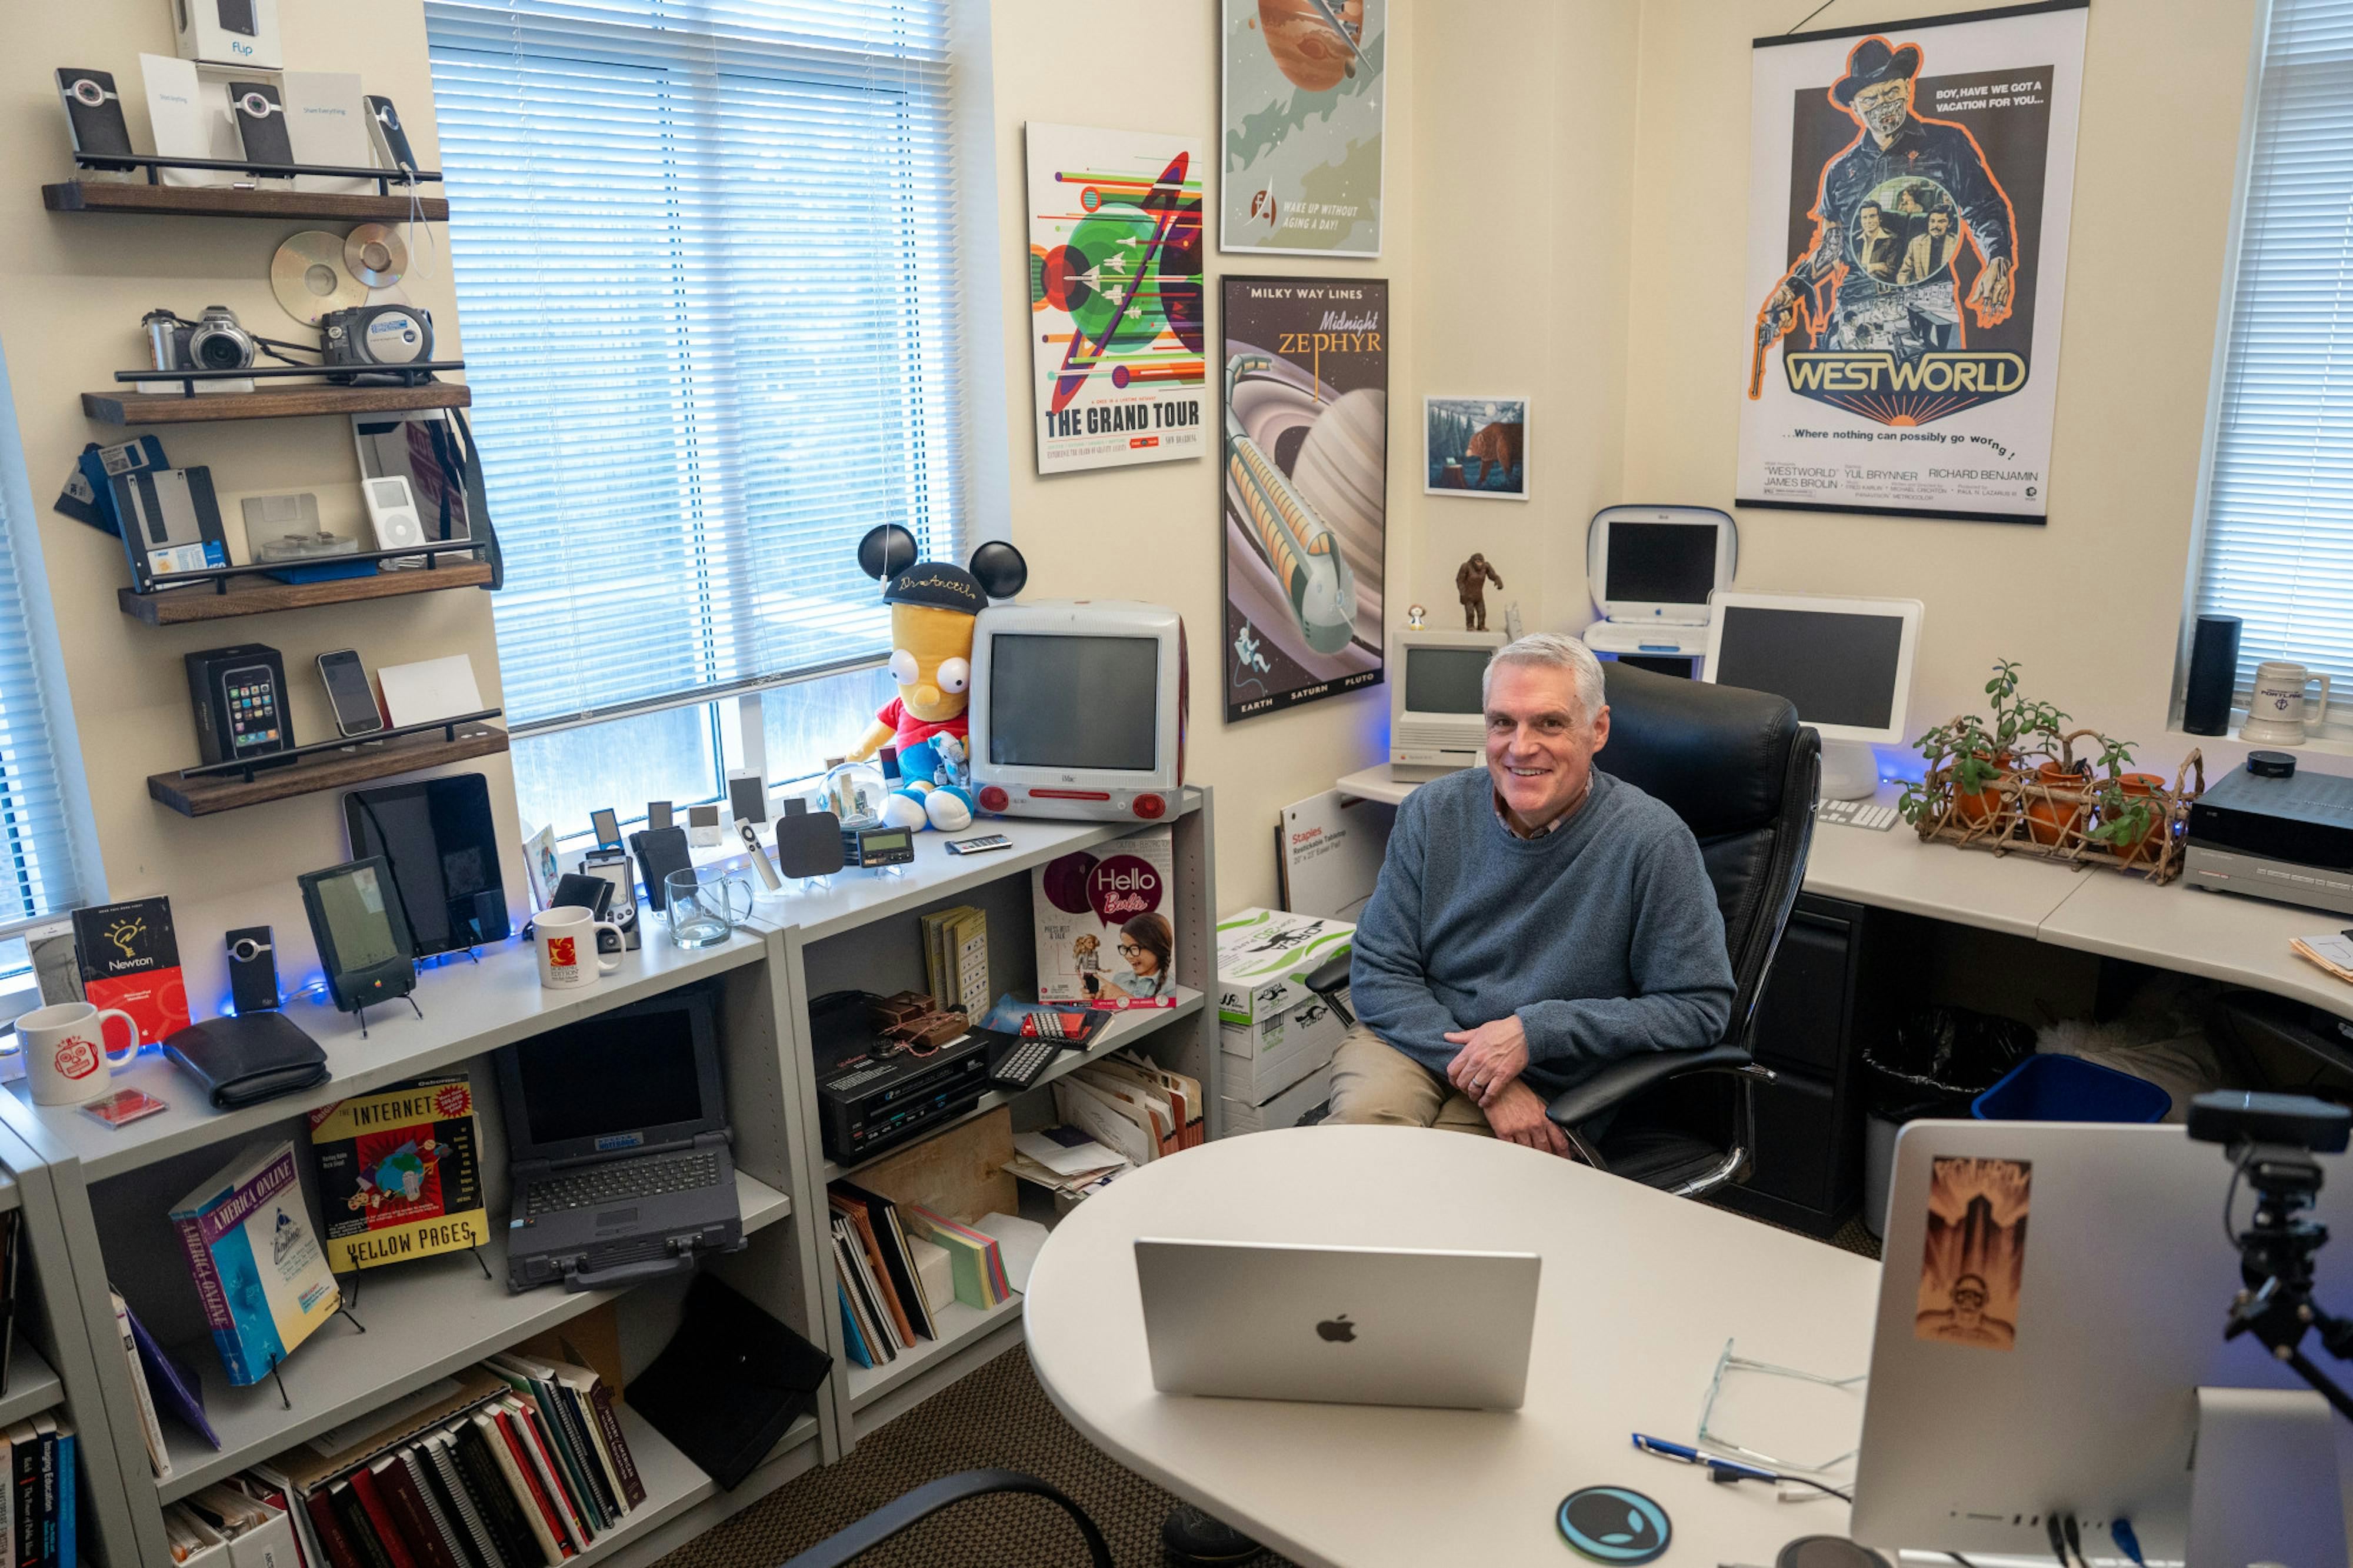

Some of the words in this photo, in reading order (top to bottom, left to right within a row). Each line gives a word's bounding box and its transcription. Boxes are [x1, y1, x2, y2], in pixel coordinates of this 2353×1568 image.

[1936, 89, 1959, 99] BOY,
[1960, 86, 1988, 96] HAVE
[1991, 84, 2009, 94] WE
[2011, 82, 2033, 92] GOT
[2034, 81, 2042, 90] A
[1936, 100, 1987, 112] VACATION
[1988, 98, 2011, 108] FOR
[2014, 95, 2044, 106] YOU...
[1284, 201, 1306, 213] WAKE
[1308, 203, 1319, 214] UP
[1321, 204, 1358, 217] WITHOUT
[1282, 218, 1309, 229] AGING
[1311, 219, 1317, 229] A
[1319, 219, 1338, 230] DAY!
[1251, 288, 1292, 298] MILKY
[1297, 289, 1324, 299] WAY
[1329, 289, 1363, 299] LINES
[1319, 311, 1378, 337] Midnight
[1787, 353, 2025, 392] WESTWORLD
[1046, 409, 1081, 438] THE
[1087, 405, 1149, 434] GRAND
[1153, 401, 1199, 428] TOUR
[1833, 431, 1873, 441] nothing
[1900, 432, 1947, 443] possibly
[1951, 435, 1964, 444] go
[1765, 478, 1798, 487] JAMES
[1801, 479, 1837, 489] BROLIN
[1845, 469, 1864, 479] YUL
[1867, 471, 1918, 481] BRYNNER
[1929, 469, 1978, 479] RICHARD
[1981, 470, 2038, 481] BENJAMIN
[1241, 698, 1273, 712] EARTH
[1291, 684, 1328, 699] SATURN
[1345, 673, 1374, 686] PLUTO
[1062, 774, 1075, 783] iMac
[1292, 827, 1322, 845] Staples
[1098, 868, 1155, 890] Hello
[1104, 891, 1148, 913] Barbie
[109, 956, 154, 971] Newton
[418, 1078, 457, 1087] Osborne
[354, 1096, 432, 1126] INTERNET
[213, 1187, 257, 1234] AMERICA
[256, 1160, 292, 1197] ONLINE
[347, 1235, 411, 1263] YELLOW
[419, 1222, 470, 1249] PAGES
[182, 1225, 211, 1278] AMERICA
[202, 1279, 229, 1325] ONLINE
[42, 1440, 52, 1472] Imaging
[44, 1472, 54, 1512] Education
